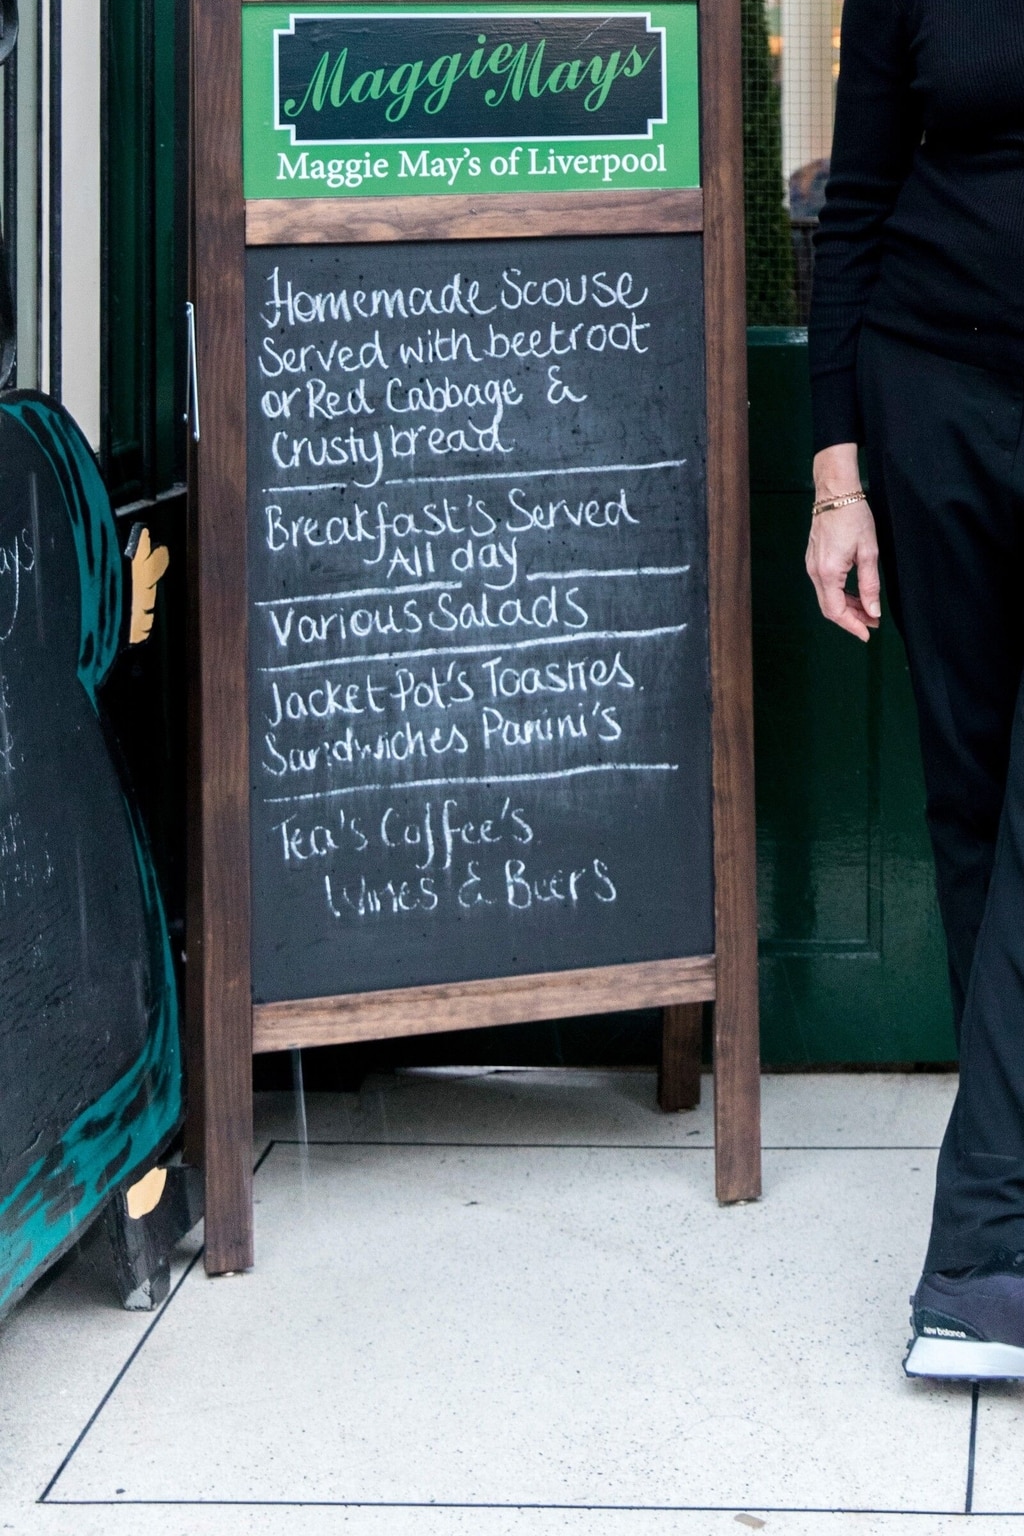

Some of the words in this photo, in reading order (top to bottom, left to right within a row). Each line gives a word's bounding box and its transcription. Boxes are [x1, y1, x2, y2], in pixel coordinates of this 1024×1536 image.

[276, 151, 389, 188] Maggie
[397, 148, 481, 186] May's
[489, 146, 519, 176] of
[527, 144, 667, 188] Liverpool
[260, 266, 497, 329] Homemade
[501, 268, 649, 309] Scouse
[258, 330, 389, 377] Served
[400, 328, 483, 362] with
[483, 311, 651, 358] beetroot
[261, 387, 302, 418] or
[306, 378, 375, 420] Red
[386, 376, 524, 424] Cabbage
[547, 365, 588, 404] &
[390, 414, 514, 453] bread
[265, 493, 496, 565] Breakfast's
[506, 488, 640, 532] Served
[387, 541, 435, 579] All
[451, 537, 517, 591] day
[269, 599, 422, 647] Various
[429, 586, 588, 632] Salads
[265, 675, 388, 727] Jacket
[390, 661, 474, 713] Pot's
[262, 722, 468, 776] Sandwiches
[482, 702, 622, 750] Panini's
[272, 809, 368, 860] Tea's
[381, 797, 534, 870] Coffee's
[325, 875, 438, 917] Wines
[505, 859, 616, 909] Beers
